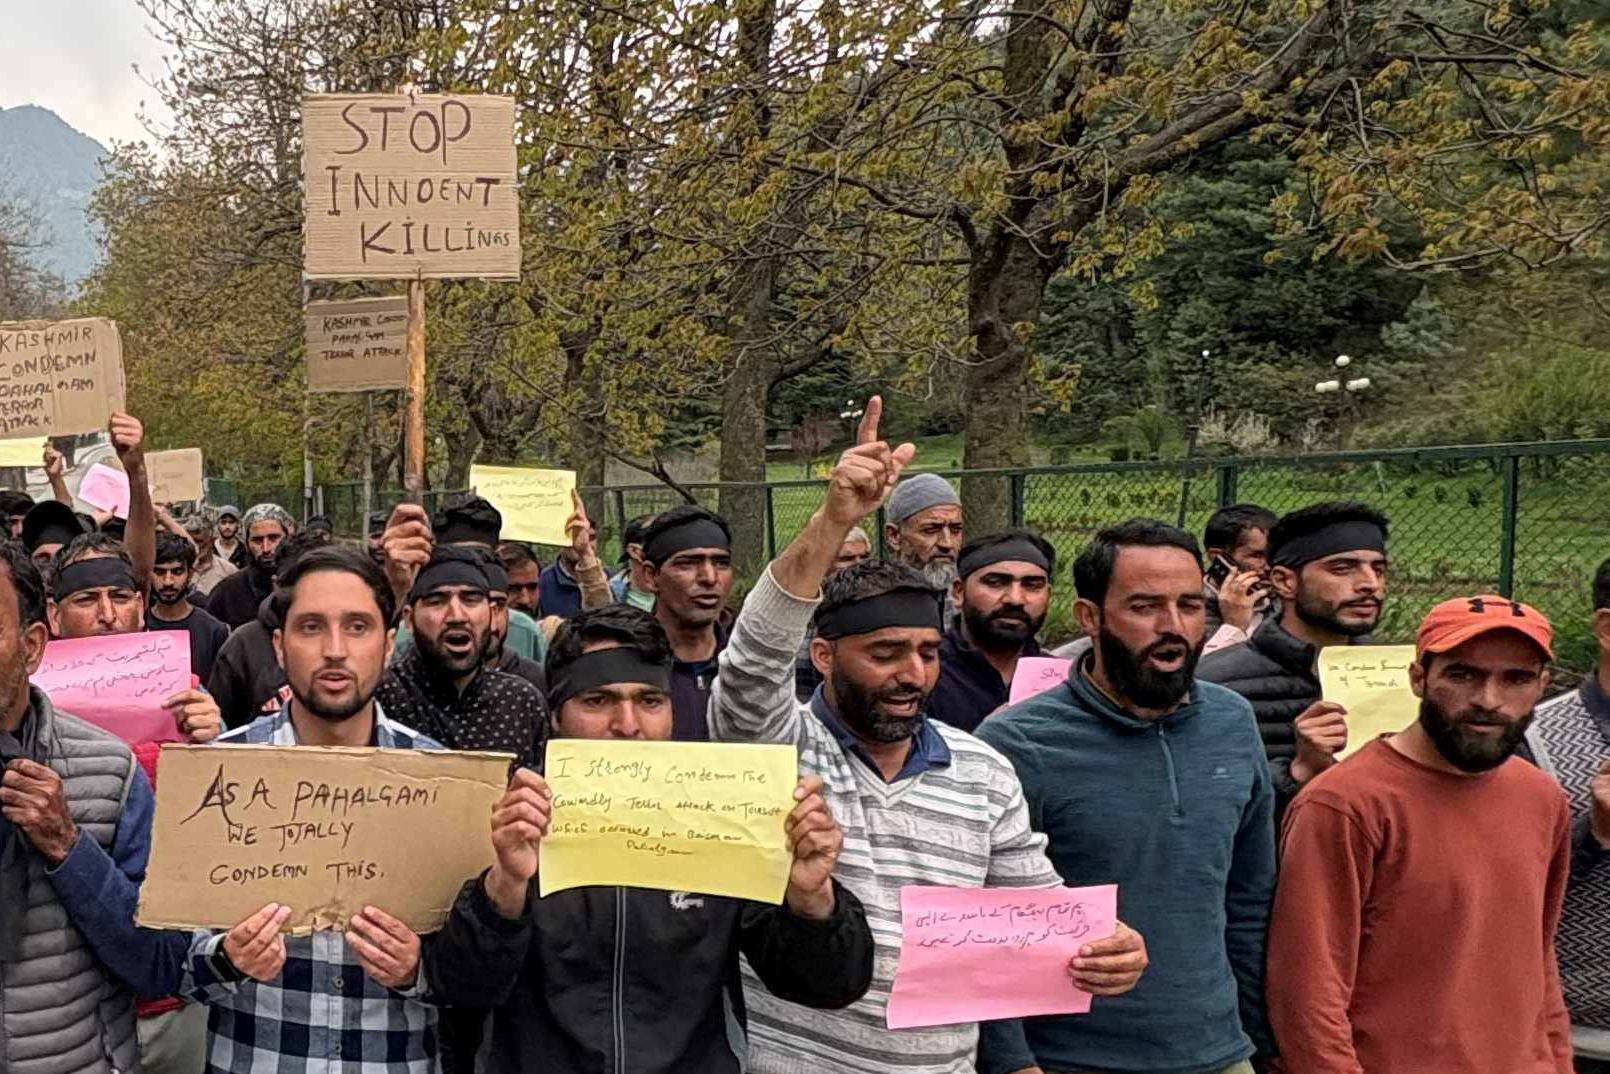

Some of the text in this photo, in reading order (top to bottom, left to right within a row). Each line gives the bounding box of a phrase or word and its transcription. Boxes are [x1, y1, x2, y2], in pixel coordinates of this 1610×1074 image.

[334, 100, 471, 165] STOP
[325, 165, 501, 216] INNOENT
[0, 326, 92, 353] KASHMIR
[553, 757, 574, 778] I
[244, 778, 277, 811] A
[292, 781, 438, 820] PAHALGAMI
[227, 822, 354, 851] WE TOTALLY
[210, 864, 308, 885] CONDEMN
